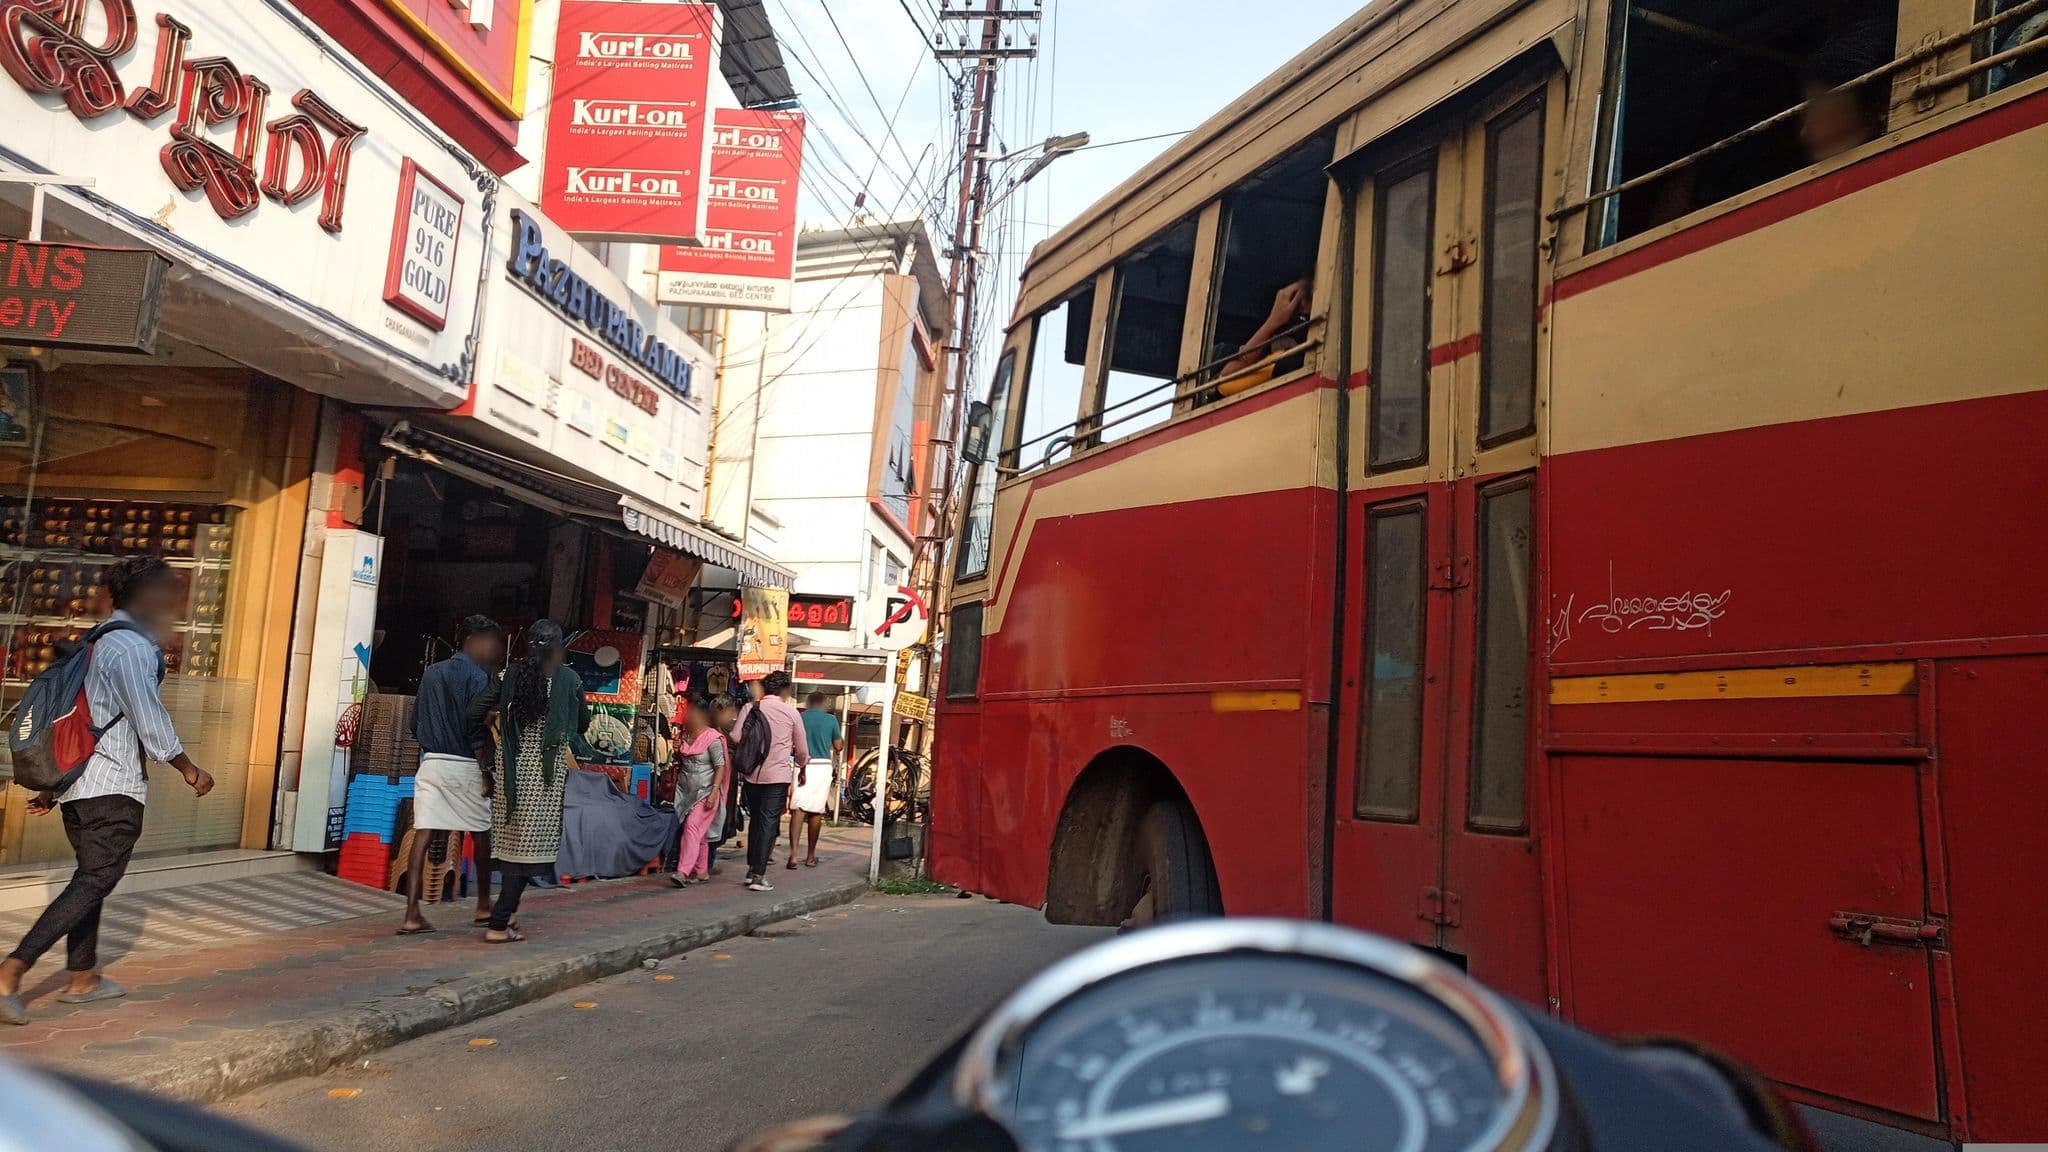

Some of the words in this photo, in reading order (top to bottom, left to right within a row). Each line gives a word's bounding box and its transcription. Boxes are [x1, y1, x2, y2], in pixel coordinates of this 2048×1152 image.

[577, 32, 693, 60] Kurl-on
[576, 59, 601, 67] India's
[633, 61, 659, 70] Selling
[660, 62, 693, 70] Mattress
[571, 99, 687, 128] Kurl-on
[570, 127, 595, 135] India's
[597, 128, 625, 136] Largest
[627, 129, 654, 137] Selling
[655, 130, 688, 138] Mattress
[565, 167, 681, 197] Kurl-on
[413, 188, 456, 240] PURE
[564, 195, 589, 203] India's
[591, 196, 619, 204] Largest
[621, 197, 647, 206] Selling
[649, 198, 682, 206] Mattress
[415, 227, 444, 267] 916
[0, 243, 86, 291] NS
[405, 259, 446, 304] GOLD
[745, 293, 772, 301] CENTRE
[570, 338, 603, 381] BED
[606, 364, 659, 417] CENTRE
